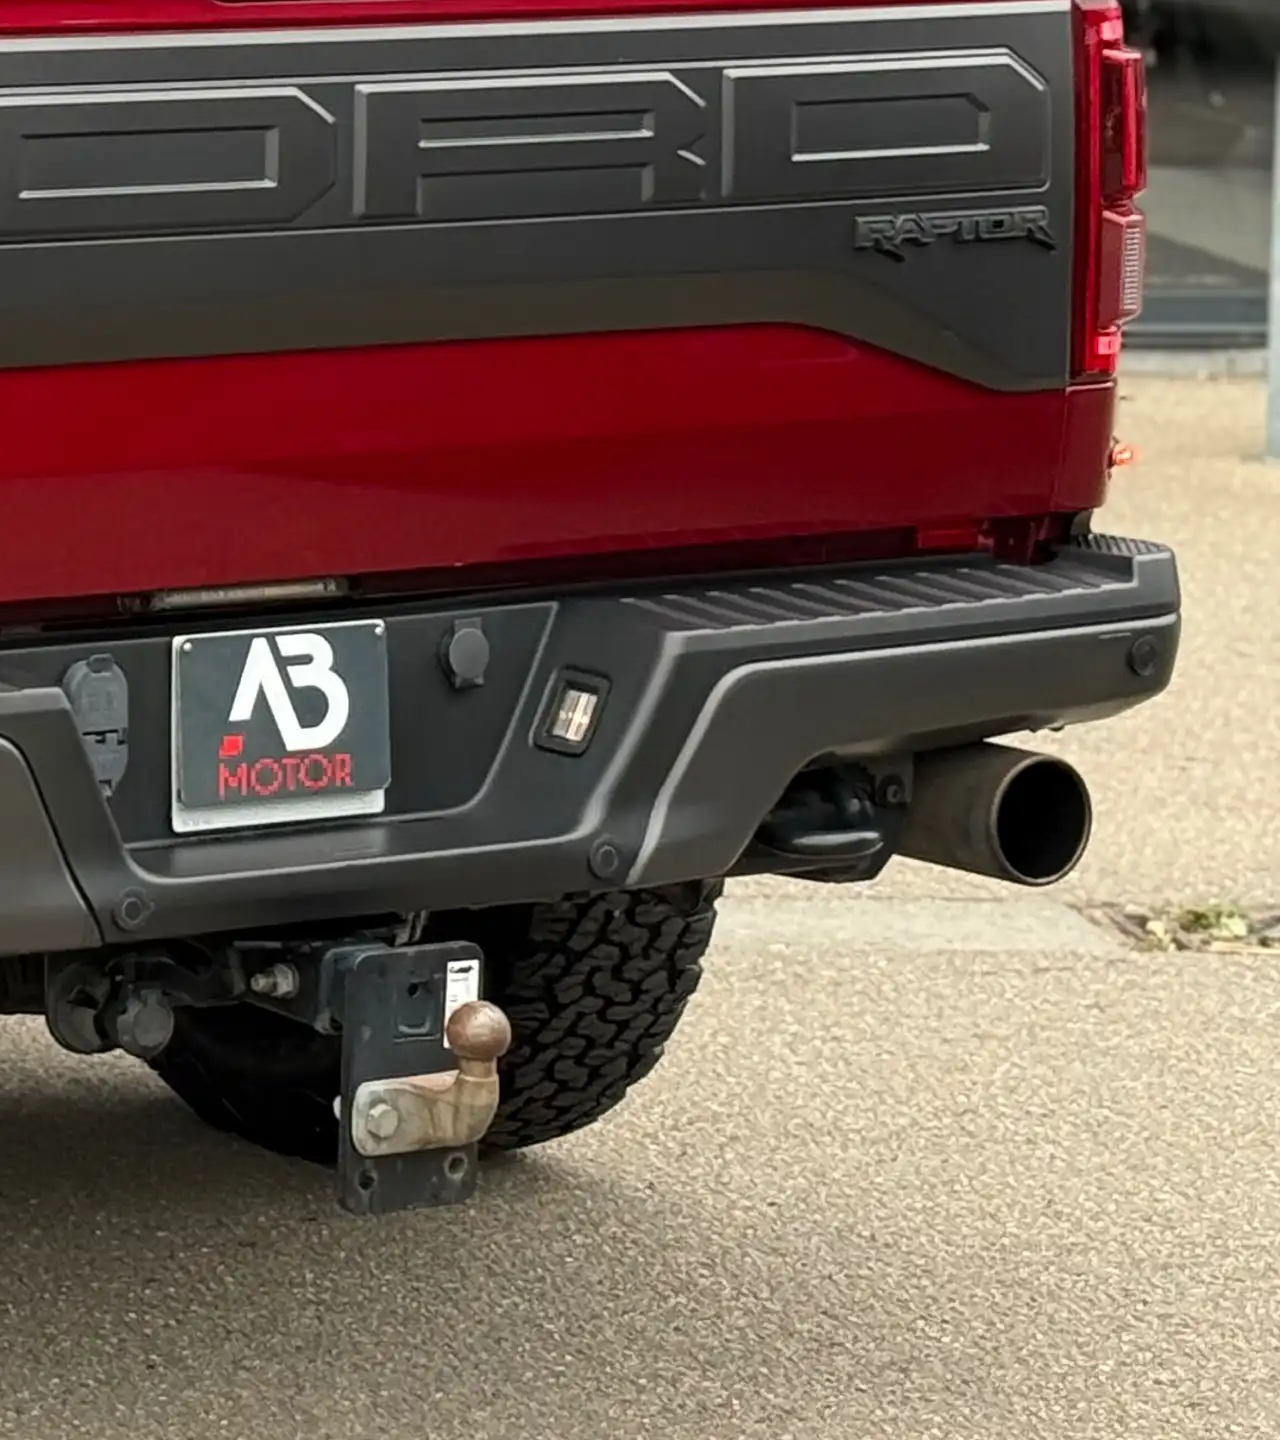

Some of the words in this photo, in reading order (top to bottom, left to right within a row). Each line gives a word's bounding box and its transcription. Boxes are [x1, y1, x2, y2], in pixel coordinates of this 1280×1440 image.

[853, 206, 1060, 262] RAPTOR
[228, 632, 349, 751] AB
[218, 753, 355, 800] MOTOR
